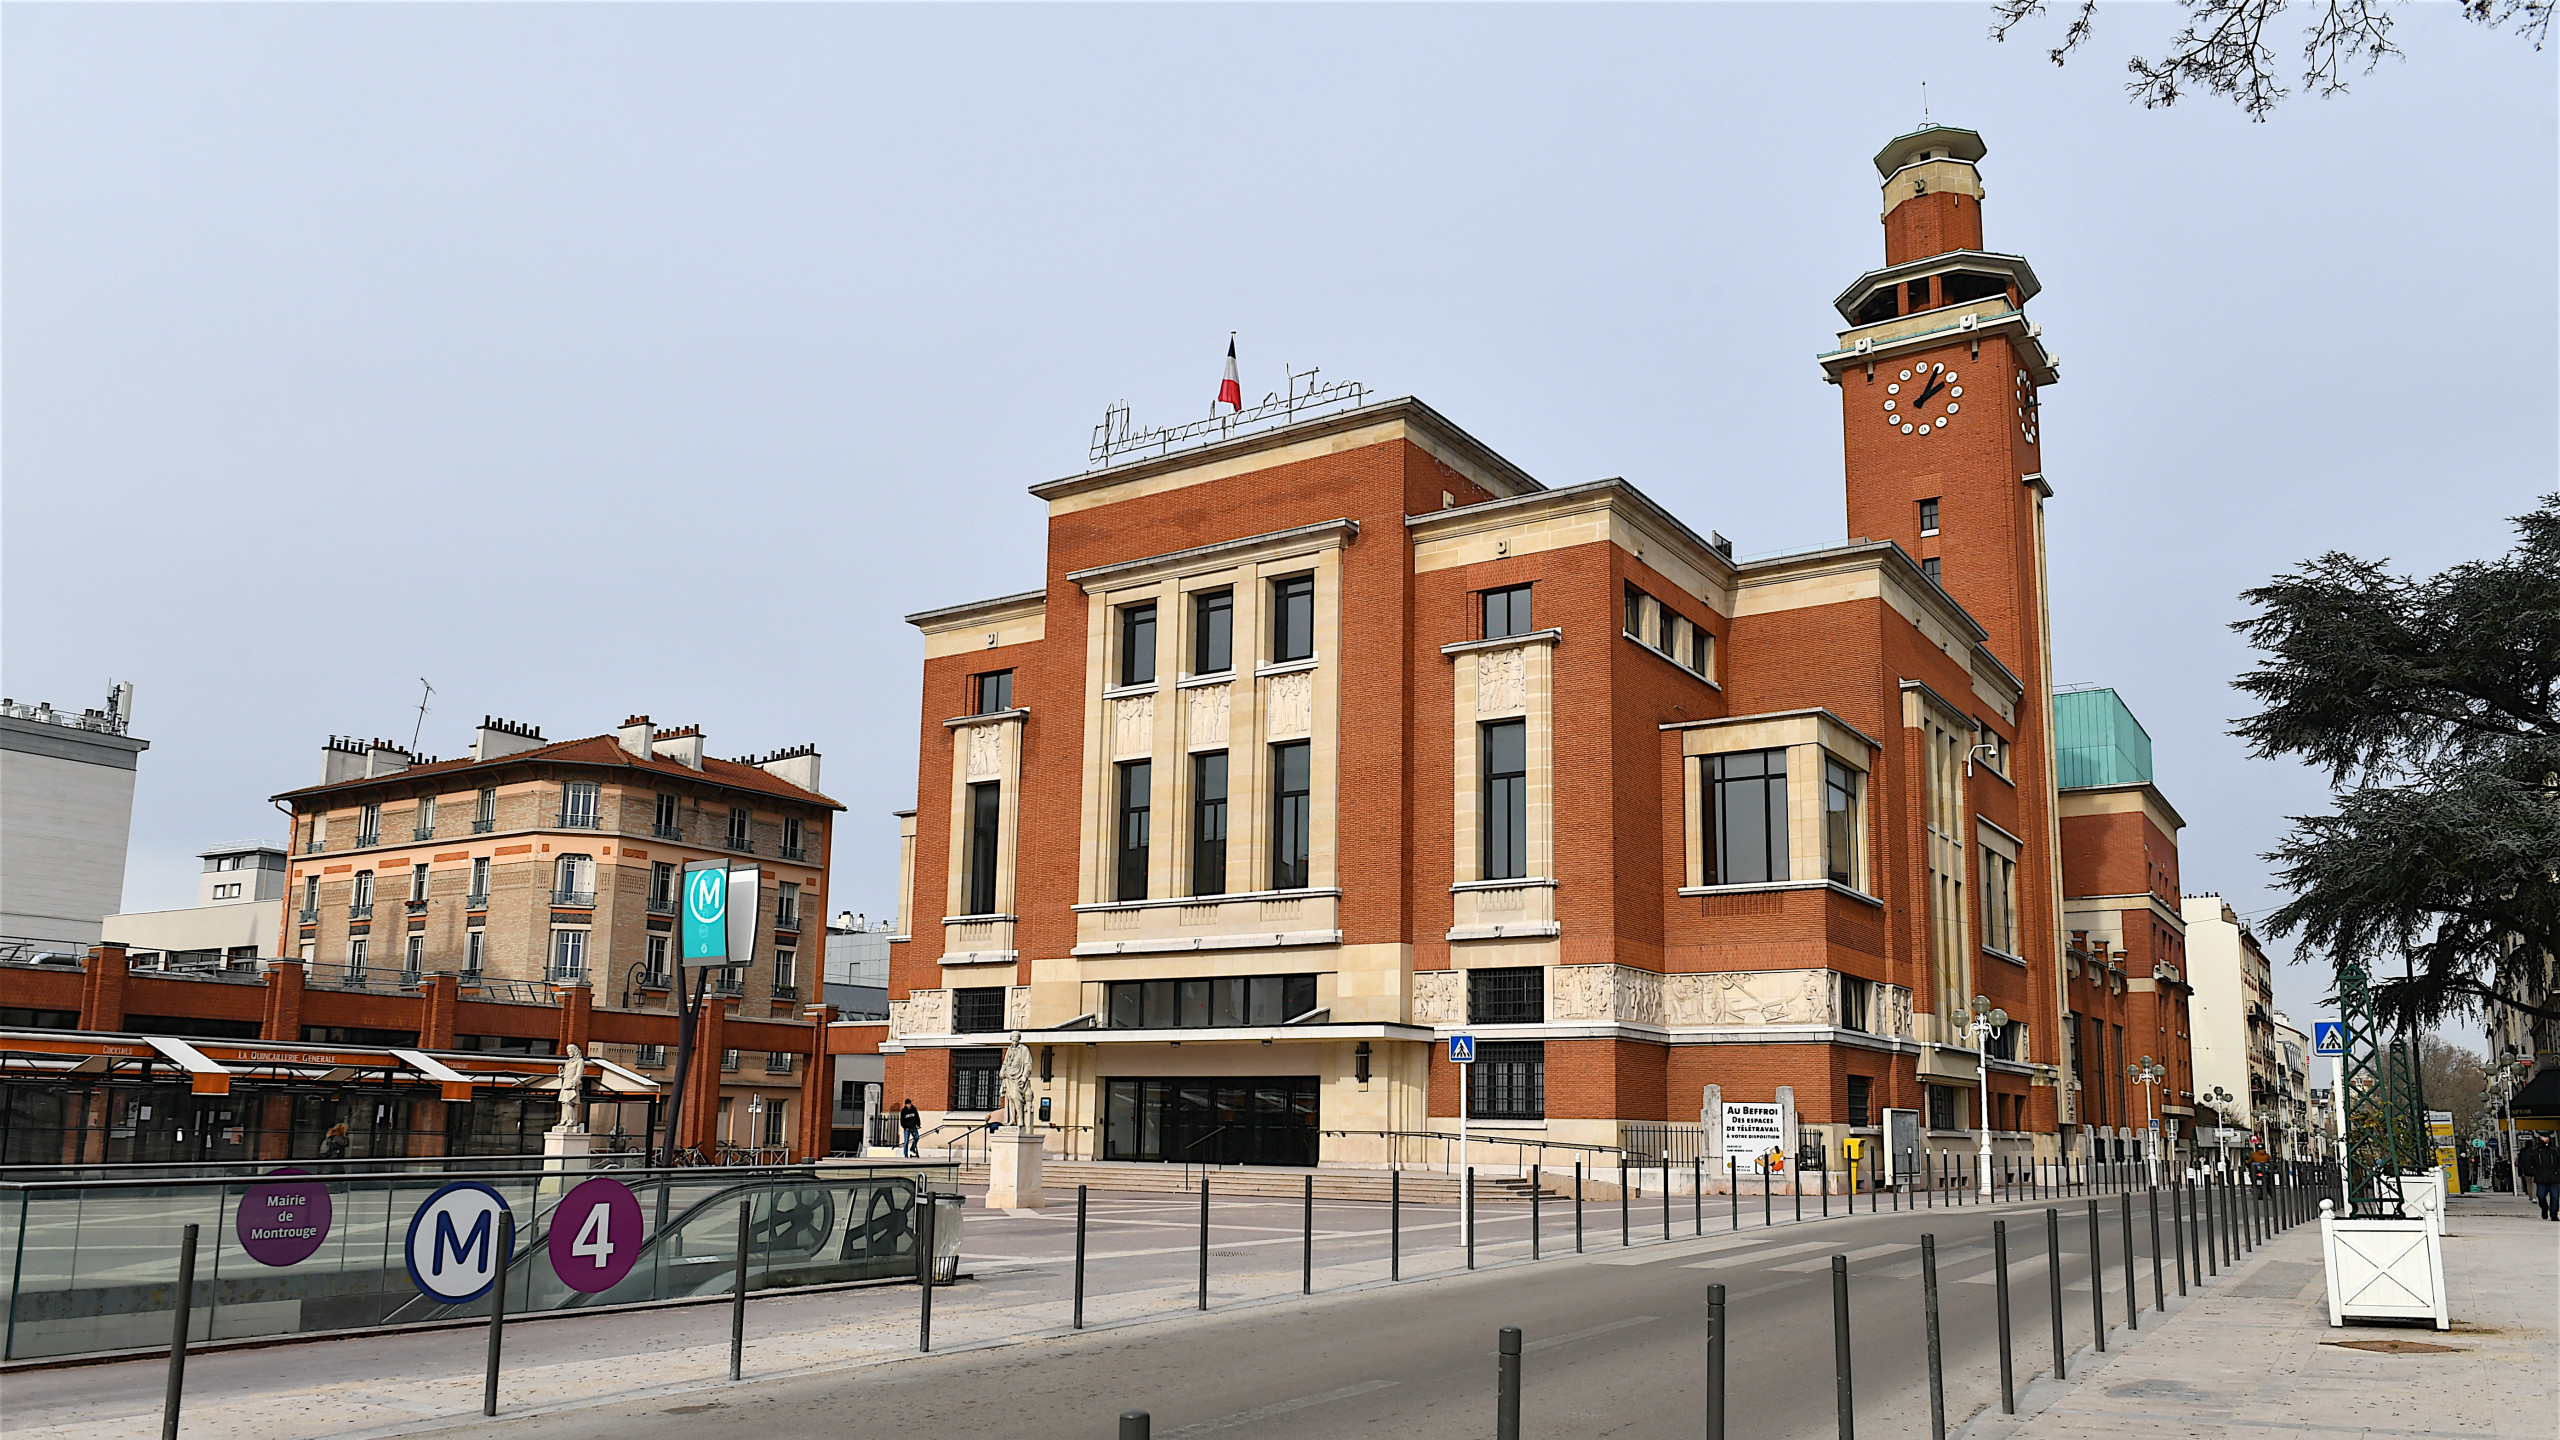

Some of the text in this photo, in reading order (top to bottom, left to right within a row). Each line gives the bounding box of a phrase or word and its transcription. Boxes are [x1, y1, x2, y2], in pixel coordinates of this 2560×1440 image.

[698, 877, 721, 910] M
[238, 1050, 247, 1059] LA
[1727, 1106, 1778, 1115] AU BEFFROI
[266, 1194, 306, 1207] Mairie
[277, 1211, 293, 1222] de
[250, 1224, 317, 1242] Montrouge
[571, 1203, 614, 1268] 4
[432, 1209, 490, 1276] M
